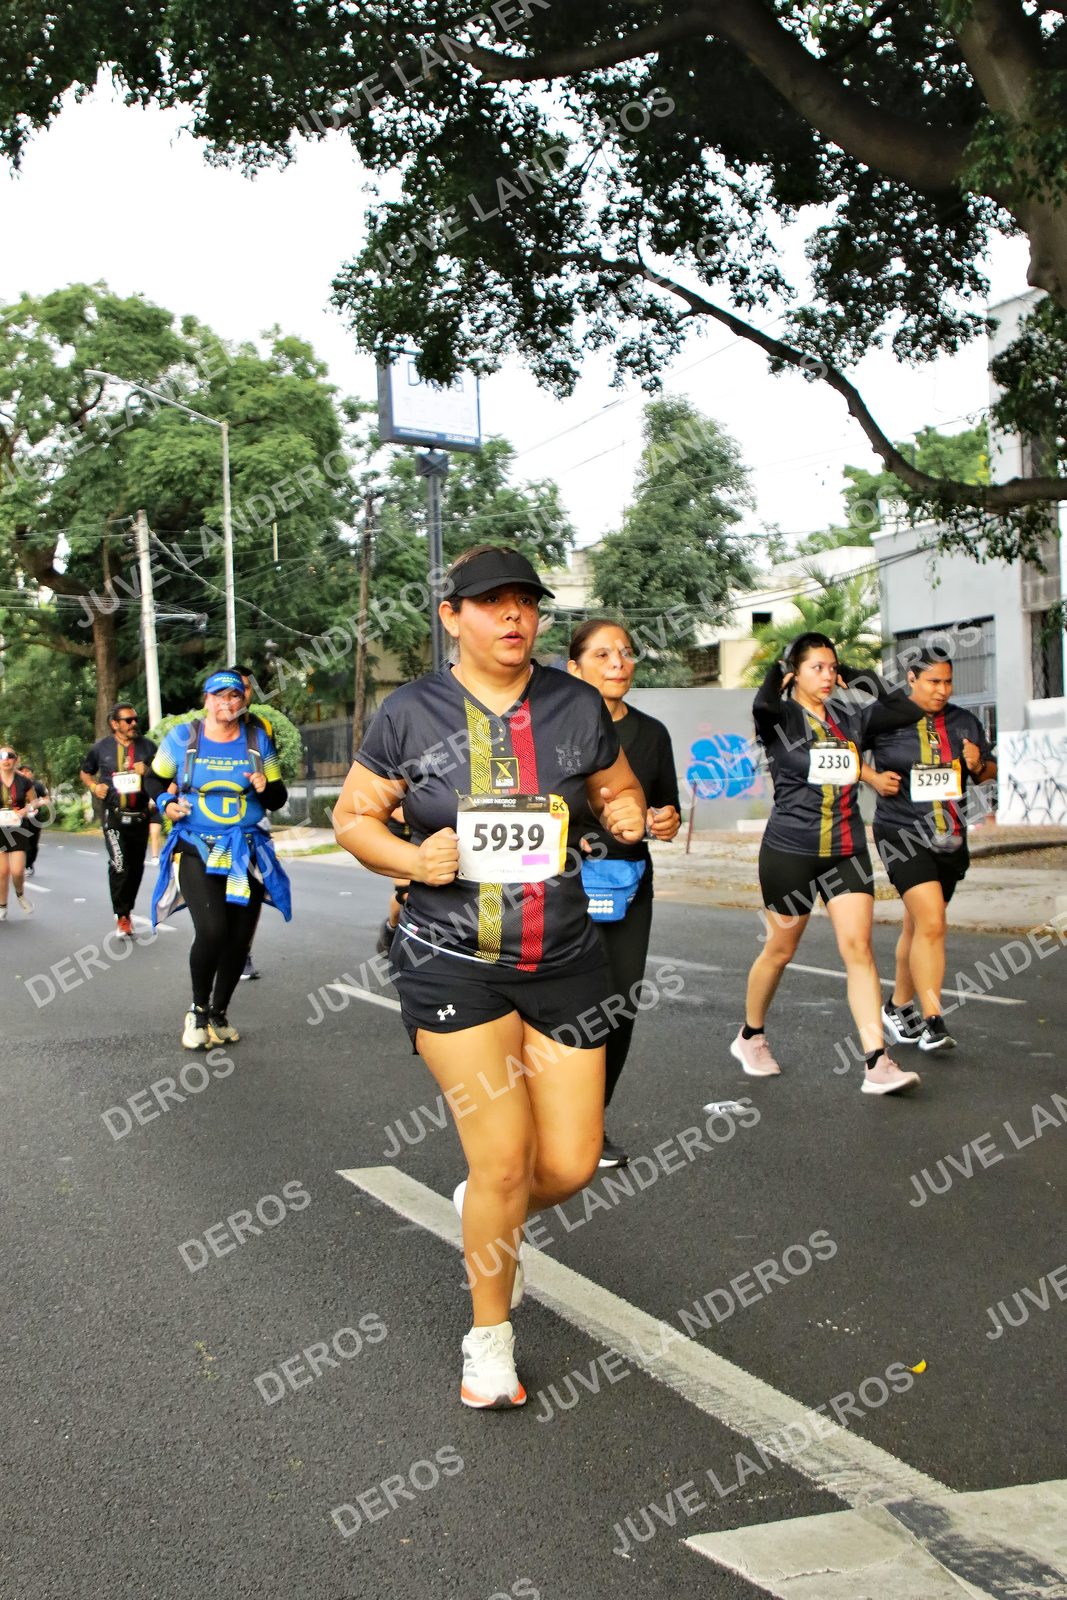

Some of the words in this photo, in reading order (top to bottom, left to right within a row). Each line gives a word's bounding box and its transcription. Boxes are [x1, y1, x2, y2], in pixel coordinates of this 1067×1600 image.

[818, 755, 850, 769] 2330
[917, 772, 950, 787] 5299
[472, 823, 545, 851] 5939
